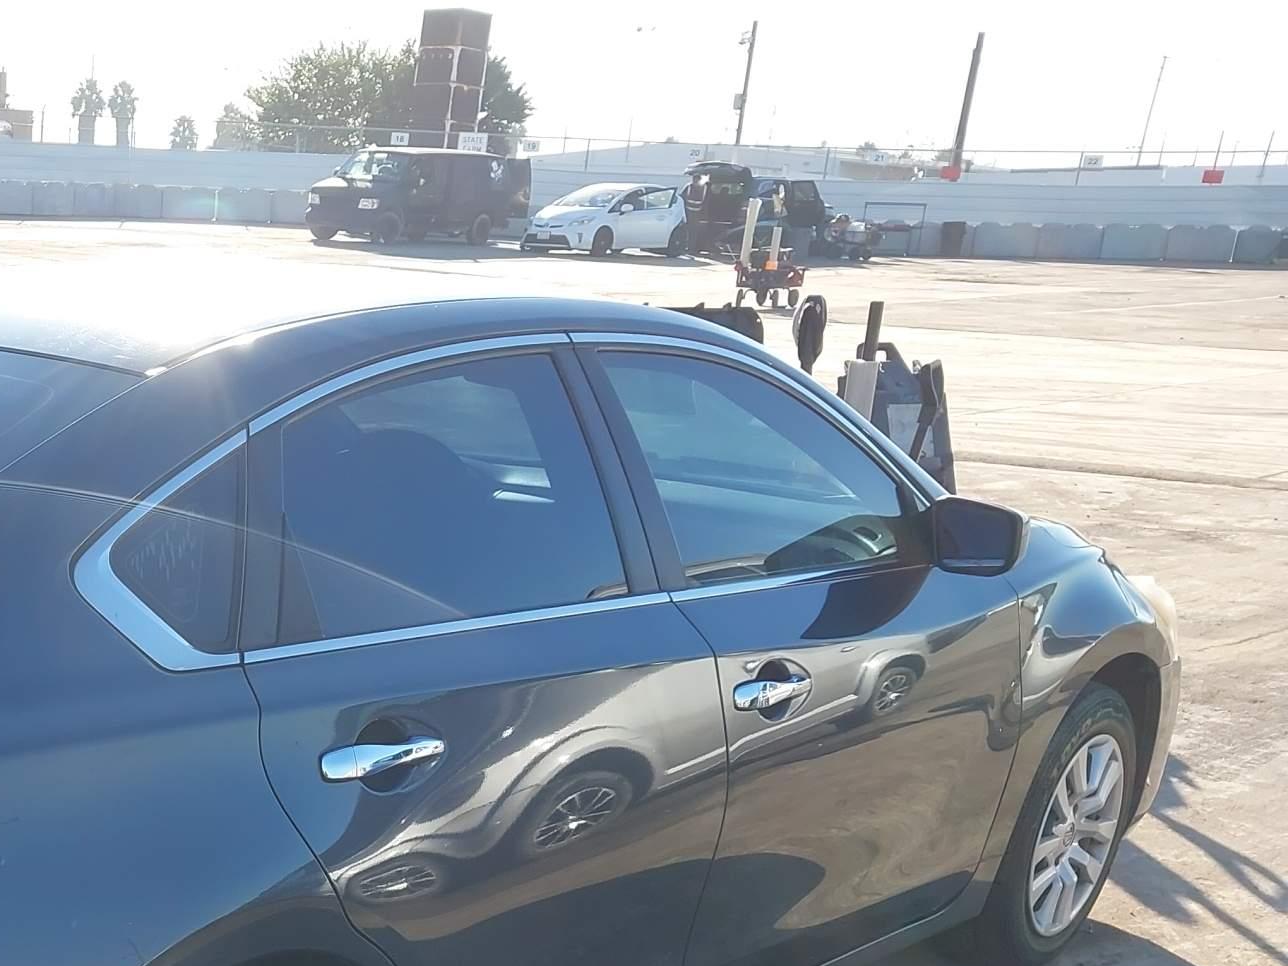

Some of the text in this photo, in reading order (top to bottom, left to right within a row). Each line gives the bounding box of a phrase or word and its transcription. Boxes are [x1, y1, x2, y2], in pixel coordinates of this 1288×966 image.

[463, 136, 483, 144] STATE
[873, 154, 884, 162] 21
[1087, 157, 1099, 165] 22
